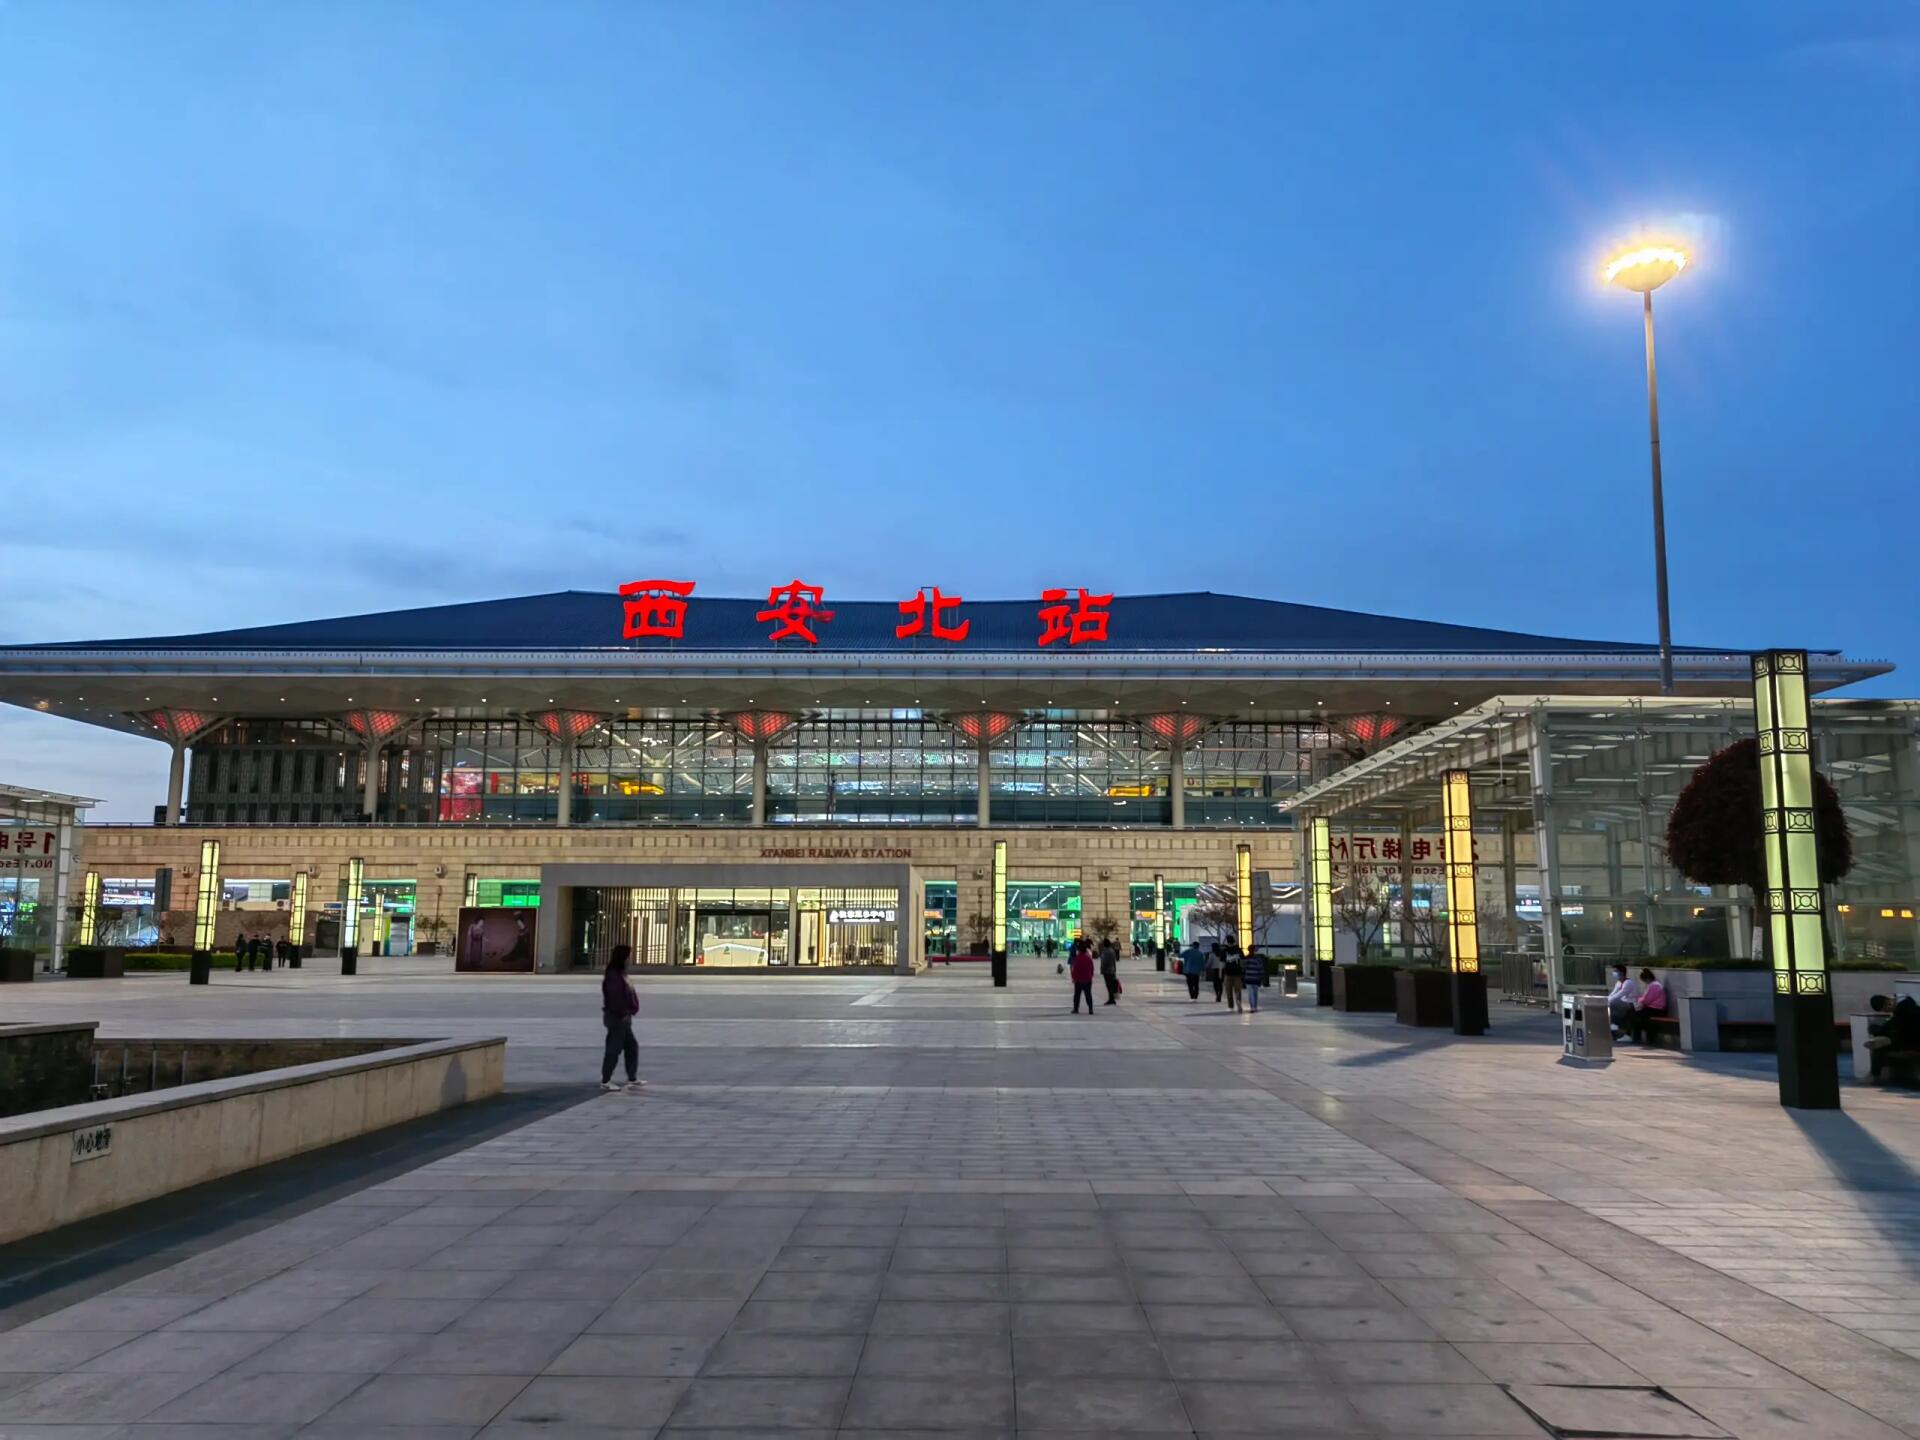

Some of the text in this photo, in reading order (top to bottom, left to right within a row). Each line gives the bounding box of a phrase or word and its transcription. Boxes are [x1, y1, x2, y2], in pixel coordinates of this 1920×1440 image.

[618, 579, 1113, 646] 西安北站
[808, 848, 857, 858] RAILWAY
[861, 848, 911, 858] STATION
